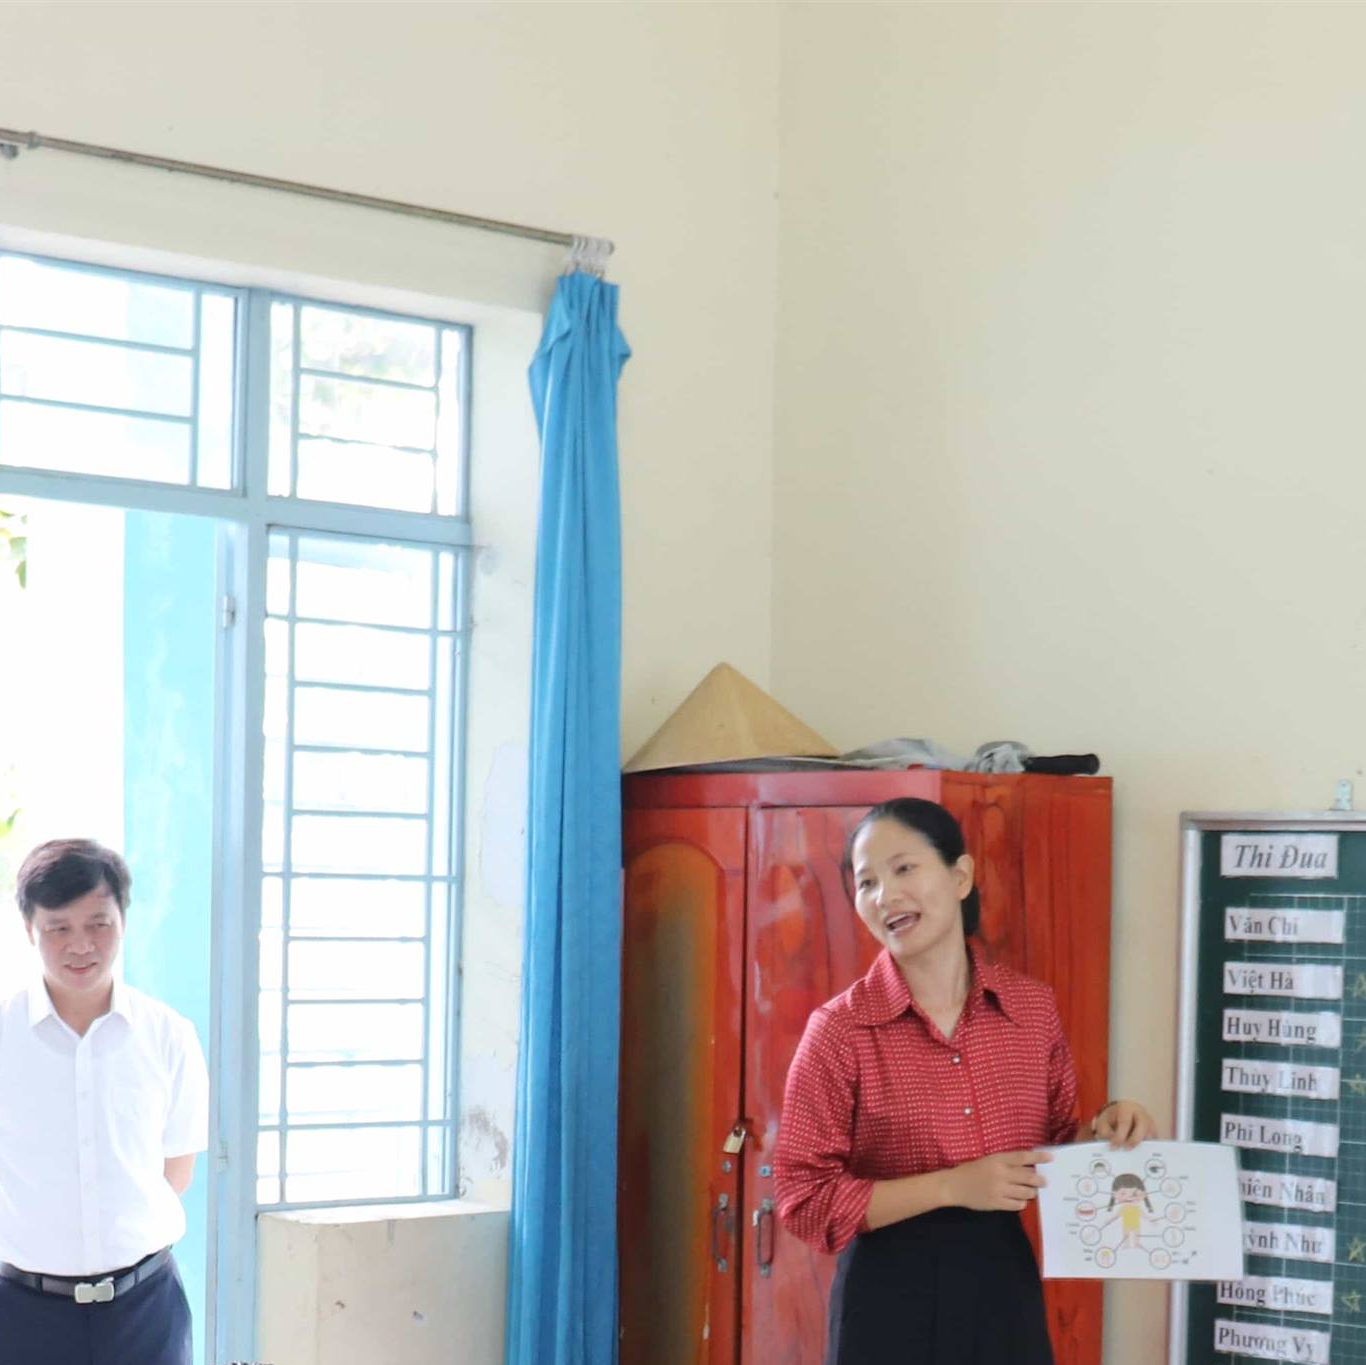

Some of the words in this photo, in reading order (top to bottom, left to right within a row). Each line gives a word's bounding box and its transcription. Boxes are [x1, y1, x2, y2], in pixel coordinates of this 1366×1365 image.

[1235, 844, 1274, 869] Thi
[1279, 844, 1327, 869] Đua
[1228, 969, 1263, 993] Việt
[1271, 971, 1294, 990] Hà
[1226, 1017, 1262, 1041] Huy
[1278, 1070, 1317, 1091] Linh
[1260, 1125, 1303, 1152] Long
[1219, 1327, 1286, 1355] Phương
[1292, 1336, 1317, 1360] Vy
